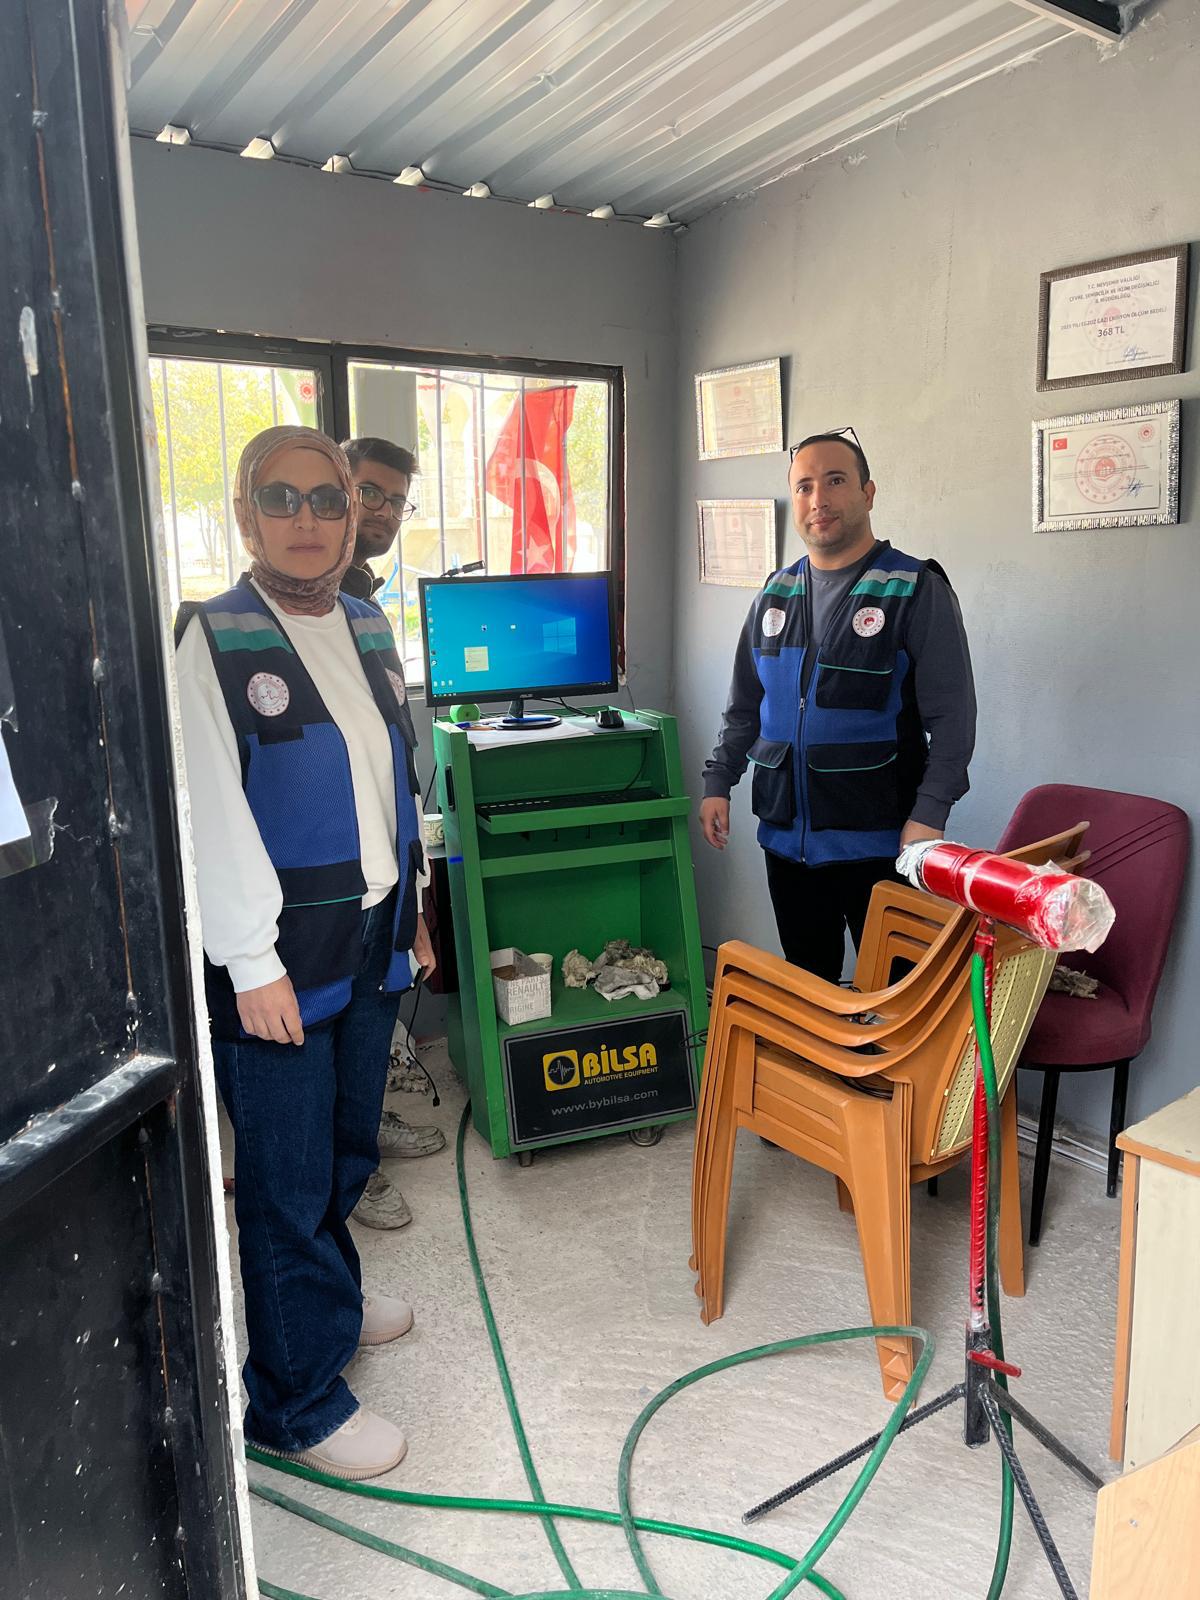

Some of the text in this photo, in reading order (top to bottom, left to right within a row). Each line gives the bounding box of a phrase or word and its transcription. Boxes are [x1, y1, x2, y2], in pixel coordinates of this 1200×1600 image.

[1097, 325, 1125, 338] 368 TL
[584, 1067, 659, 1085] AUTOMOTIVE EQUIPMENT
[551, 1089, 658, 1116] www.bybilsa.com
